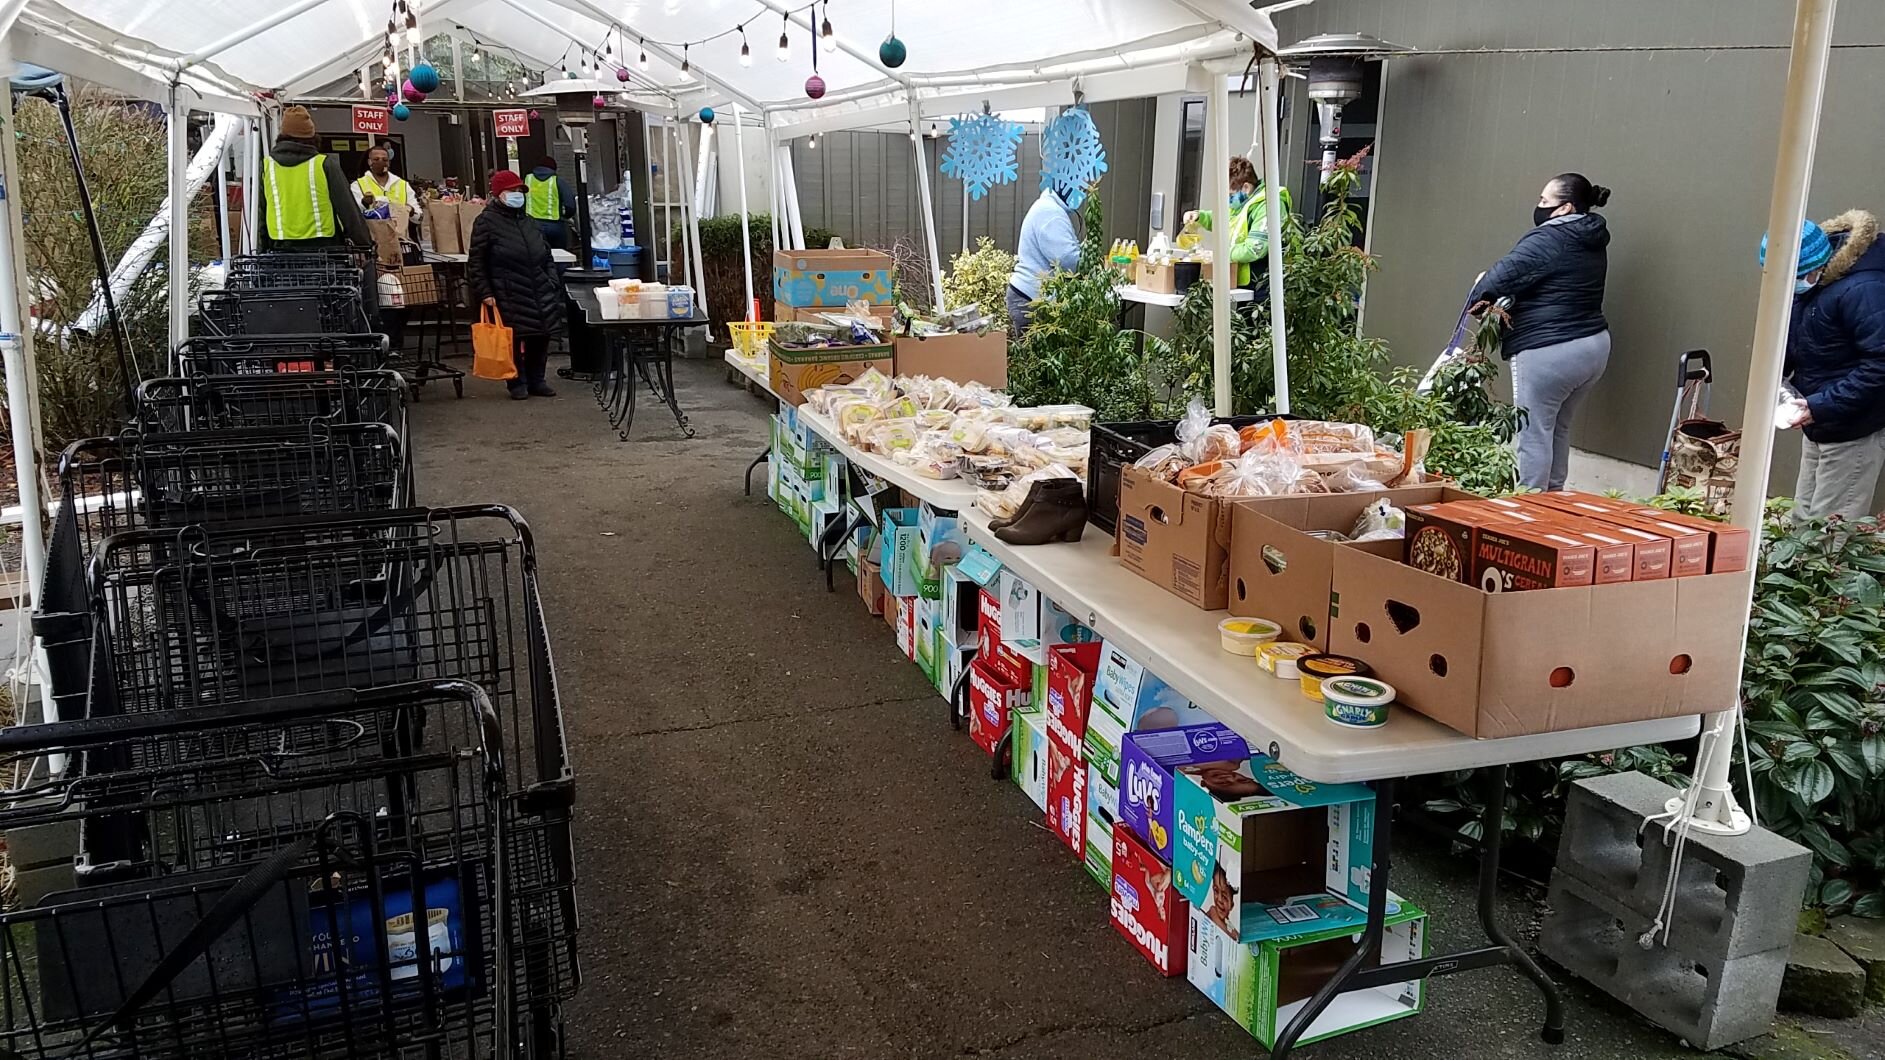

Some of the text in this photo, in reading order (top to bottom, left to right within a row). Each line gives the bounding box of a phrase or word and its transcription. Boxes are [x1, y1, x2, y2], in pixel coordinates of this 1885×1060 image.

[357, 110, 384, 120] STAFF
[498, 114, 524, 122] STAFF
[358, 121, 383, 131] ONLY
[500, 125, 524, 133] ONLY
[899, 533, 907, 551] 1200
[1478, 543, 1551, 578] MULTIGRAIN
[923, 584, 938, 593] 900
[1336, 704, 1373, 716] GNARLY
[1072, 764, 1085, 854] HUGGIES
[1178, 809, 1214, 857] Pampers
[1110, 898, 1169, 971] HUGGIES
